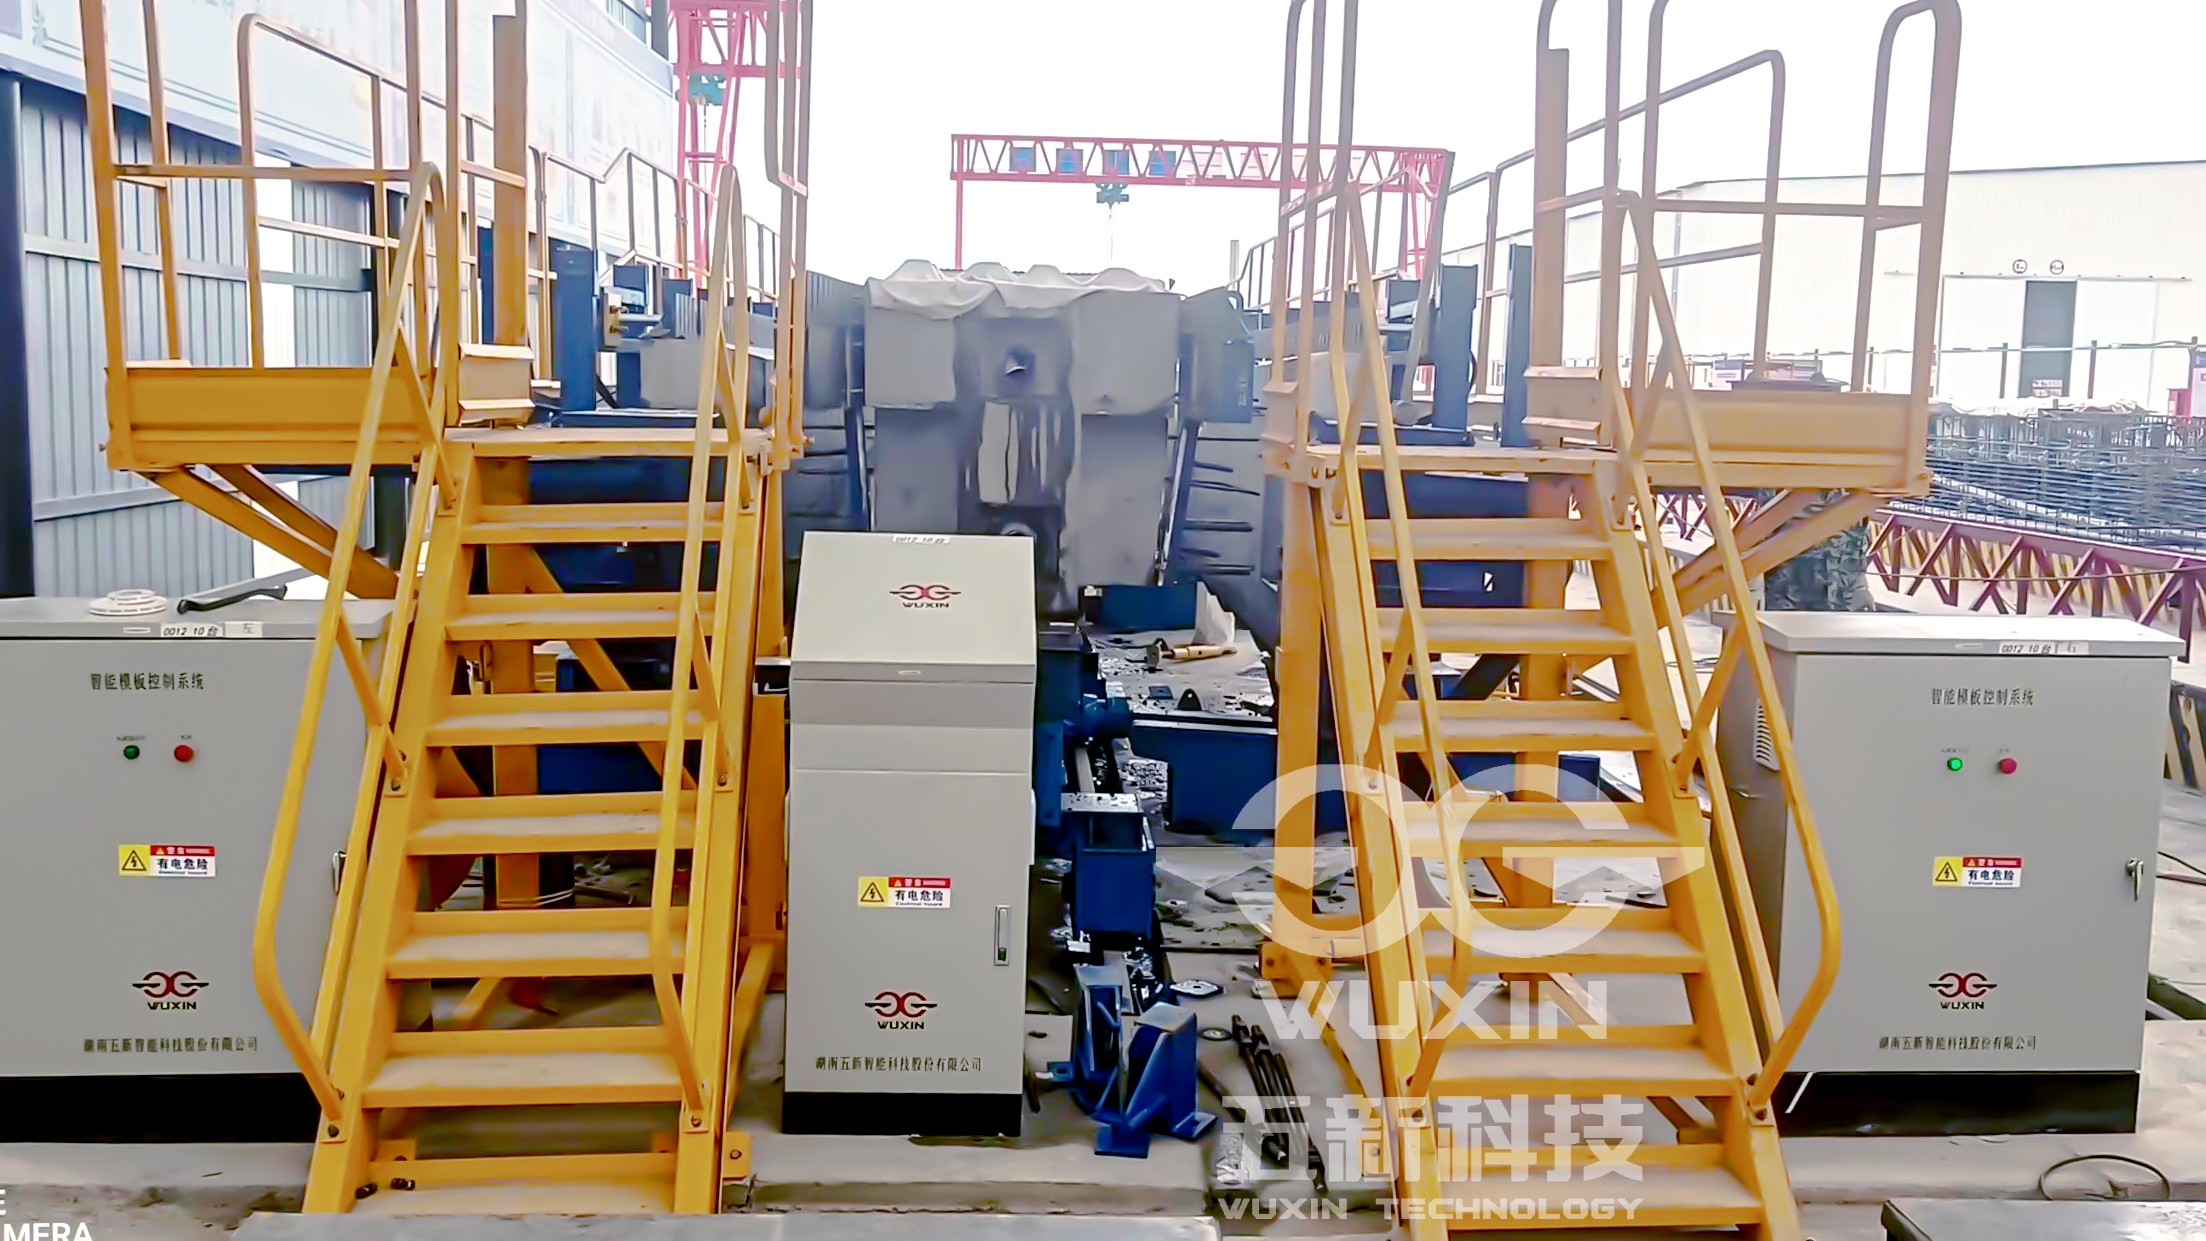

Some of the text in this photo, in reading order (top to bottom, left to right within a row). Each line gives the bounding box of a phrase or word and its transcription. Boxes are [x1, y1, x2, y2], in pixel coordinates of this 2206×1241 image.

[163, 627, 187, 636] 0012
[193, 627, 205, 635] 10
[2001, 644, 2024, 653] 0012
[2028, 644, 2040, 653] 10
[90, 673, 204, 690] 智能模板控制系统
[1932, 688, 2034, 706] 智能模板控制系统
[156, 858, 208, 870] 有电危险
[1967, 869, 2014, 881] 有电危险
[895, 889, 944, 902] 有电危险
[147, 1001, 197, 1010] WUXIN
[1940, 1002, 1985, 1010] WUXIN
[877, 1021, 925, 1030] WUXIN
